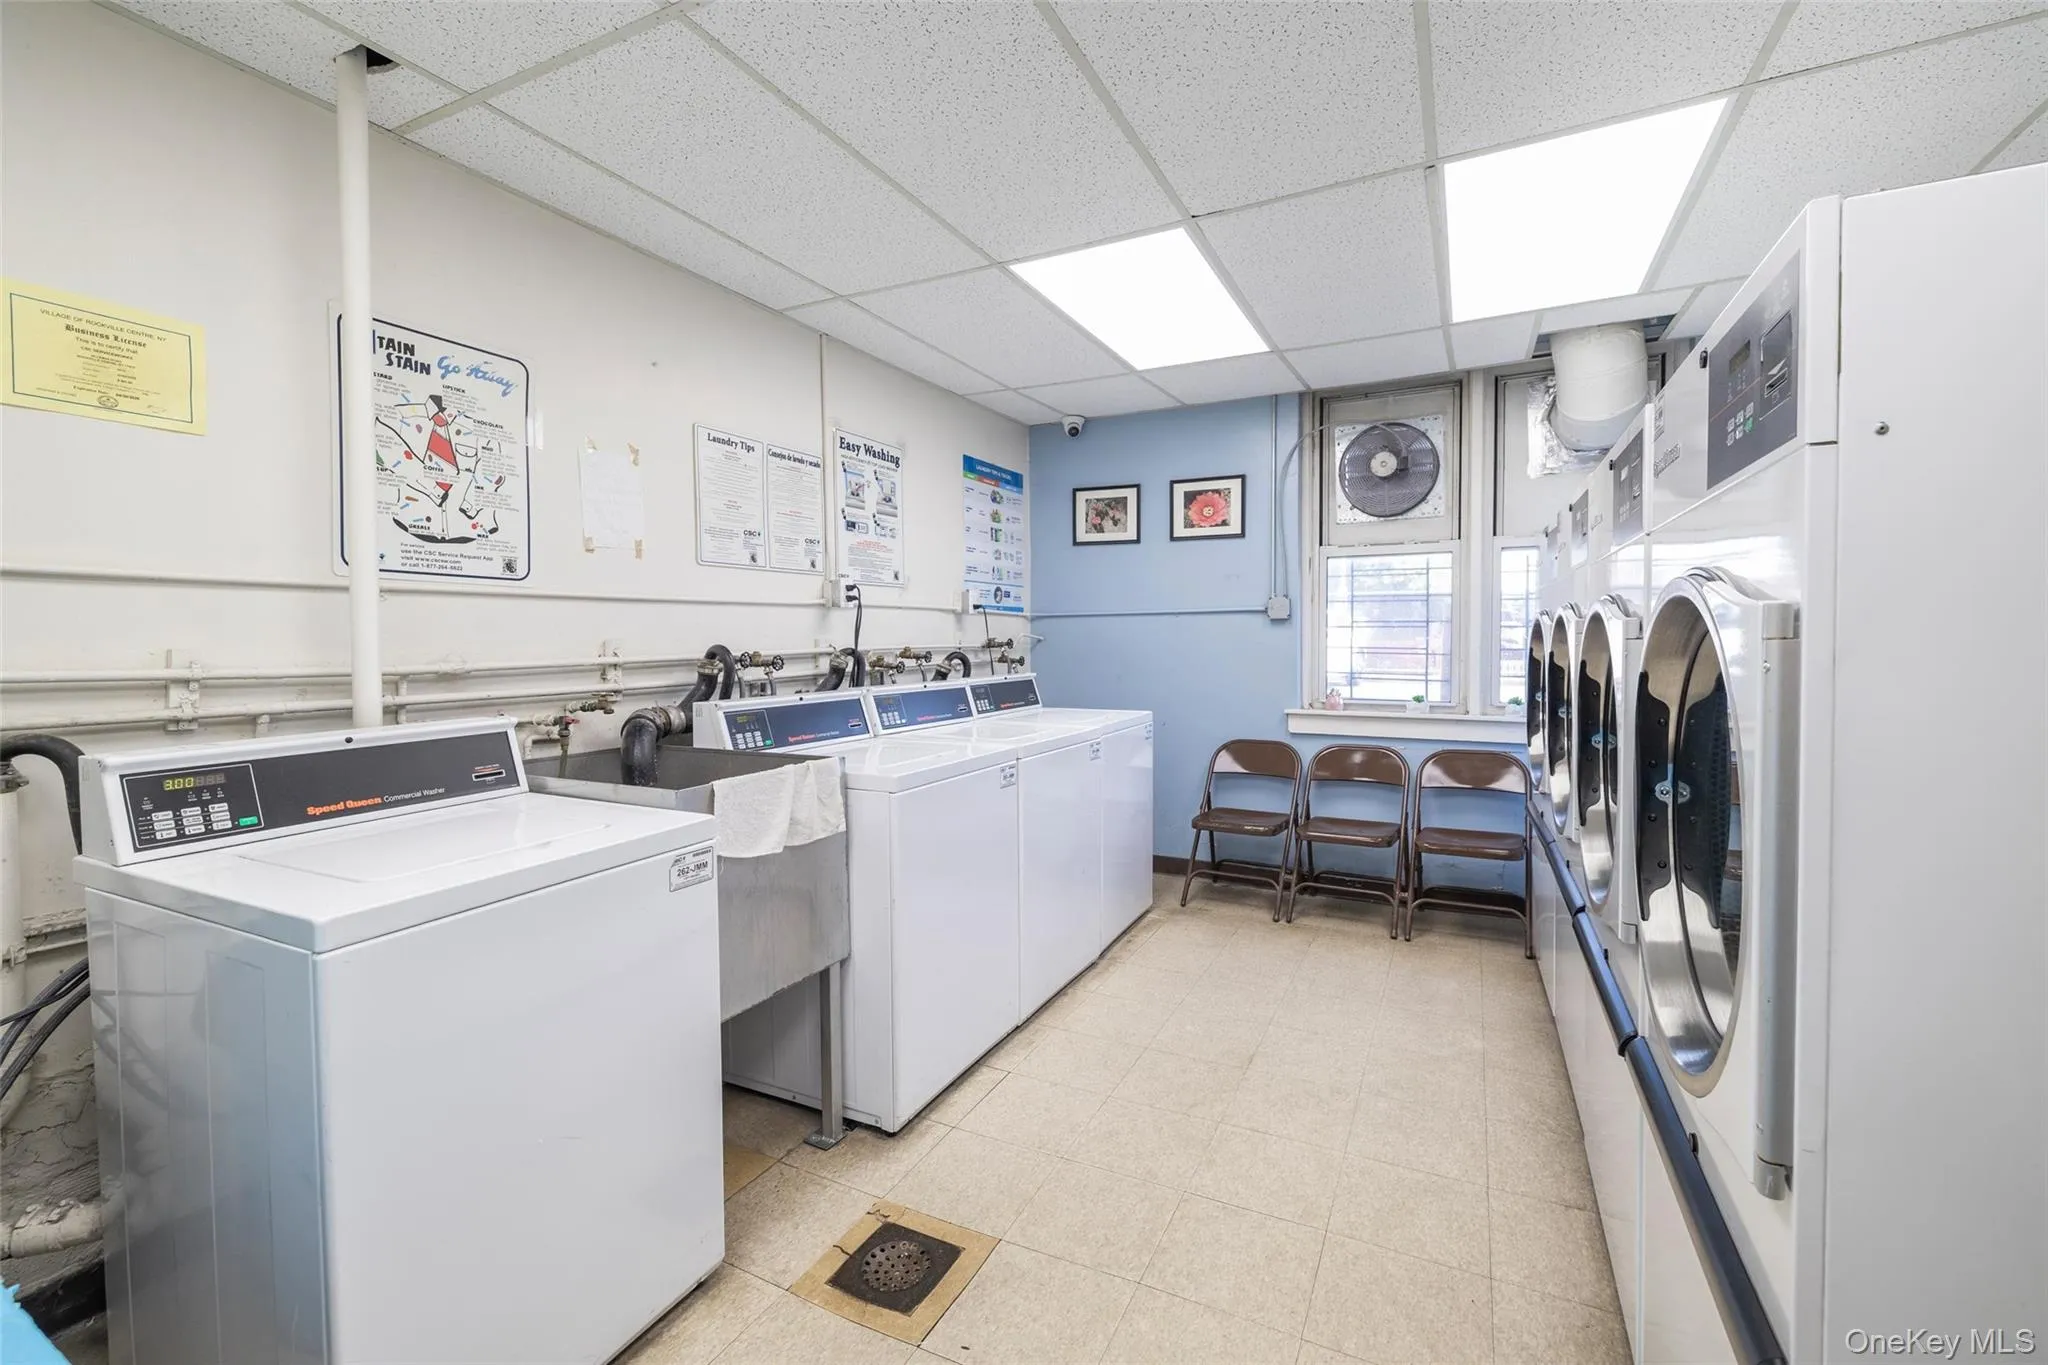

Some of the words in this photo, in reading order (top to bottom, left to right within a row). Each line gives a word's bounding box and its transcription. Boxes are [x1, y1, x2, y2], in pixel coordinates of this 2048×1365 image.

[40, 308, 71, 320] VILLAGE
[85, 319, 125, 332] ROCKVILLE
[65, 324, 110, 340] Business
[112, 334, 147, 348] License
[377, 336, 415, 356] TAIN
[385, 352, 431, 375] STAIN
[437, 356, 461, 380] Go
[466, 365, 514, 397] Away
[442, 384, 466, 394] LIPSTICK
[473, 419, 503, 429] CHOCOLATE
[707, 432, 738, 450] Laundry
[740, 440, 755, 453] Tips
[839, 436, 861, 457] Easy
[863, 443, 900, 468] Washing
[423, 465, 444, 473] COFFEE
[408, 523, 431, 531] GREASE
[460, 553, 481, 561] Request
[306, 801, 344, 816] Speed
[346, 796, 382, 810] Queen
[384, 790, 422, 803] Commercial
[423, 786, 445, 796] Washer
[677, 860, 708, 877] 262-JMM
